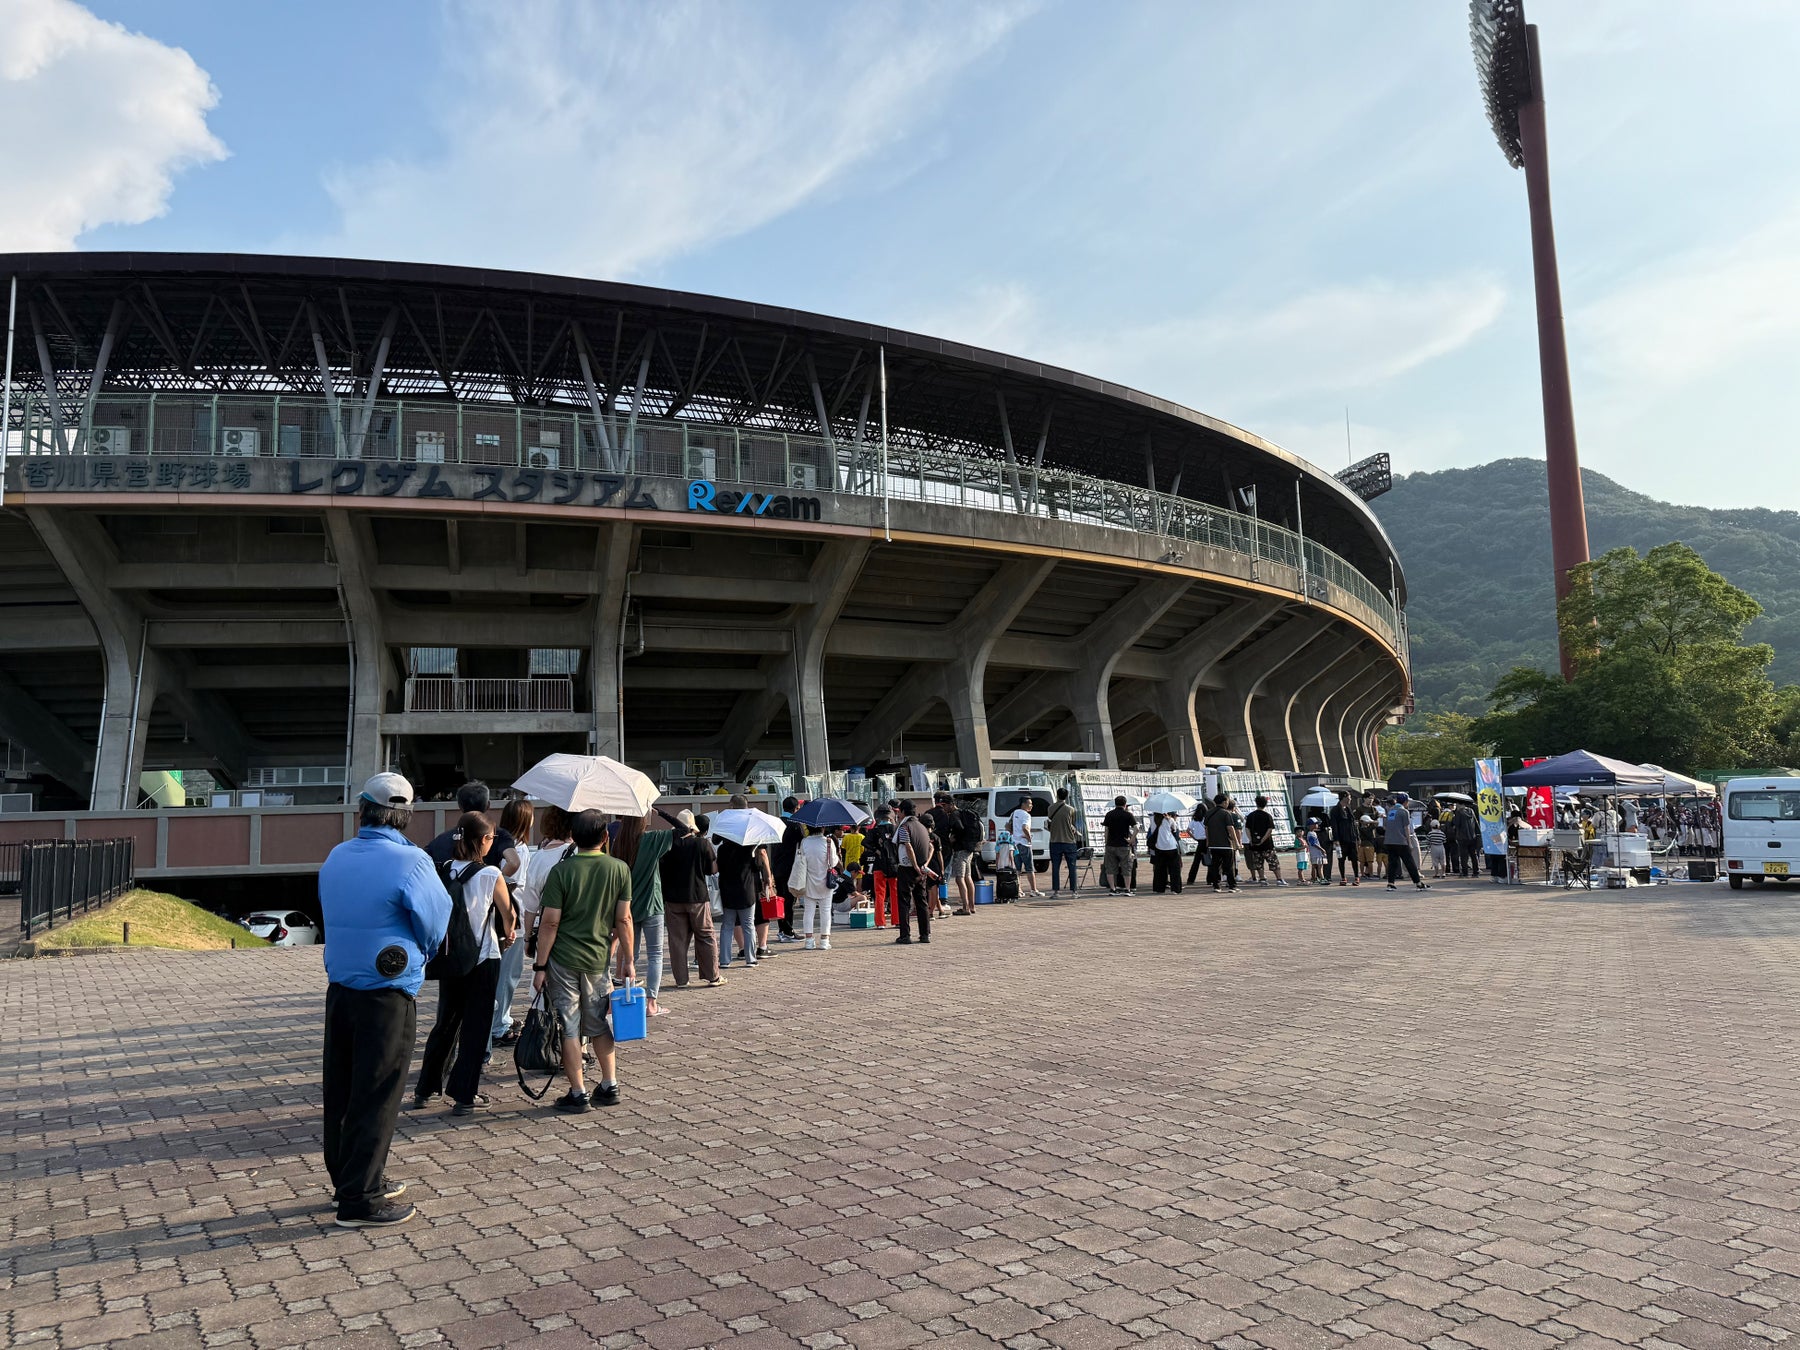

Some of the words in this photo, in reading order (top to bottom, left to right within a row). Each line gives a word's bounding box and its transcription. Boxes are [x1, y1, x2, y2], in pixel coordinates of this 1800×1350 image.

[25, 460, 252, 488] 香川県営野球場
[688, 480, 822, 521] Rexxam
